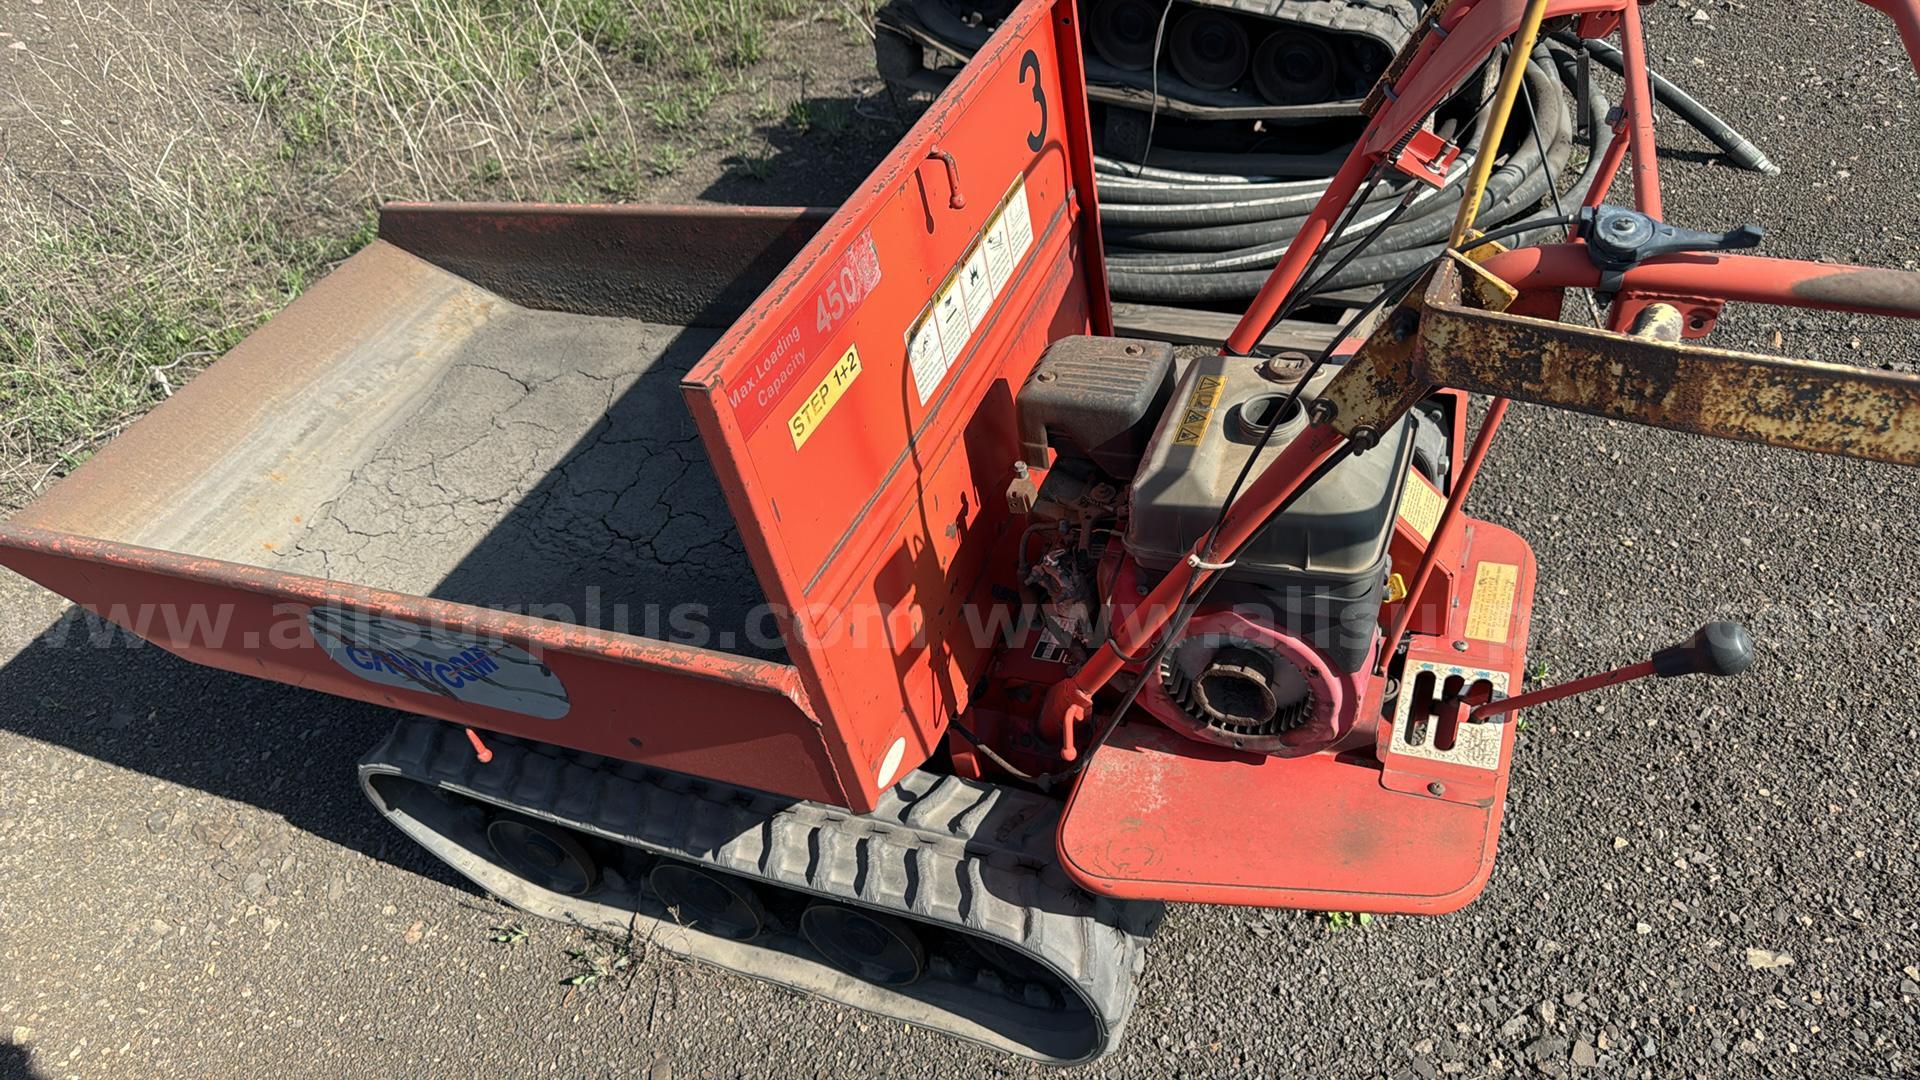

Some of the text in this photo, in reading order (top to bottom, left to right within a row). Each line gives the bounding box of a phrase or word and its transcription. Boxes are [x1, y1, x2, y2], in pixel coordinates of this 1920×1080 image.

[1019, 48, 1048, 153] 3
[815, 265, 859, 334] 450
[757, 346, 807, 408] Capacity
[792, 350, 858, 437] STEP 1+2
